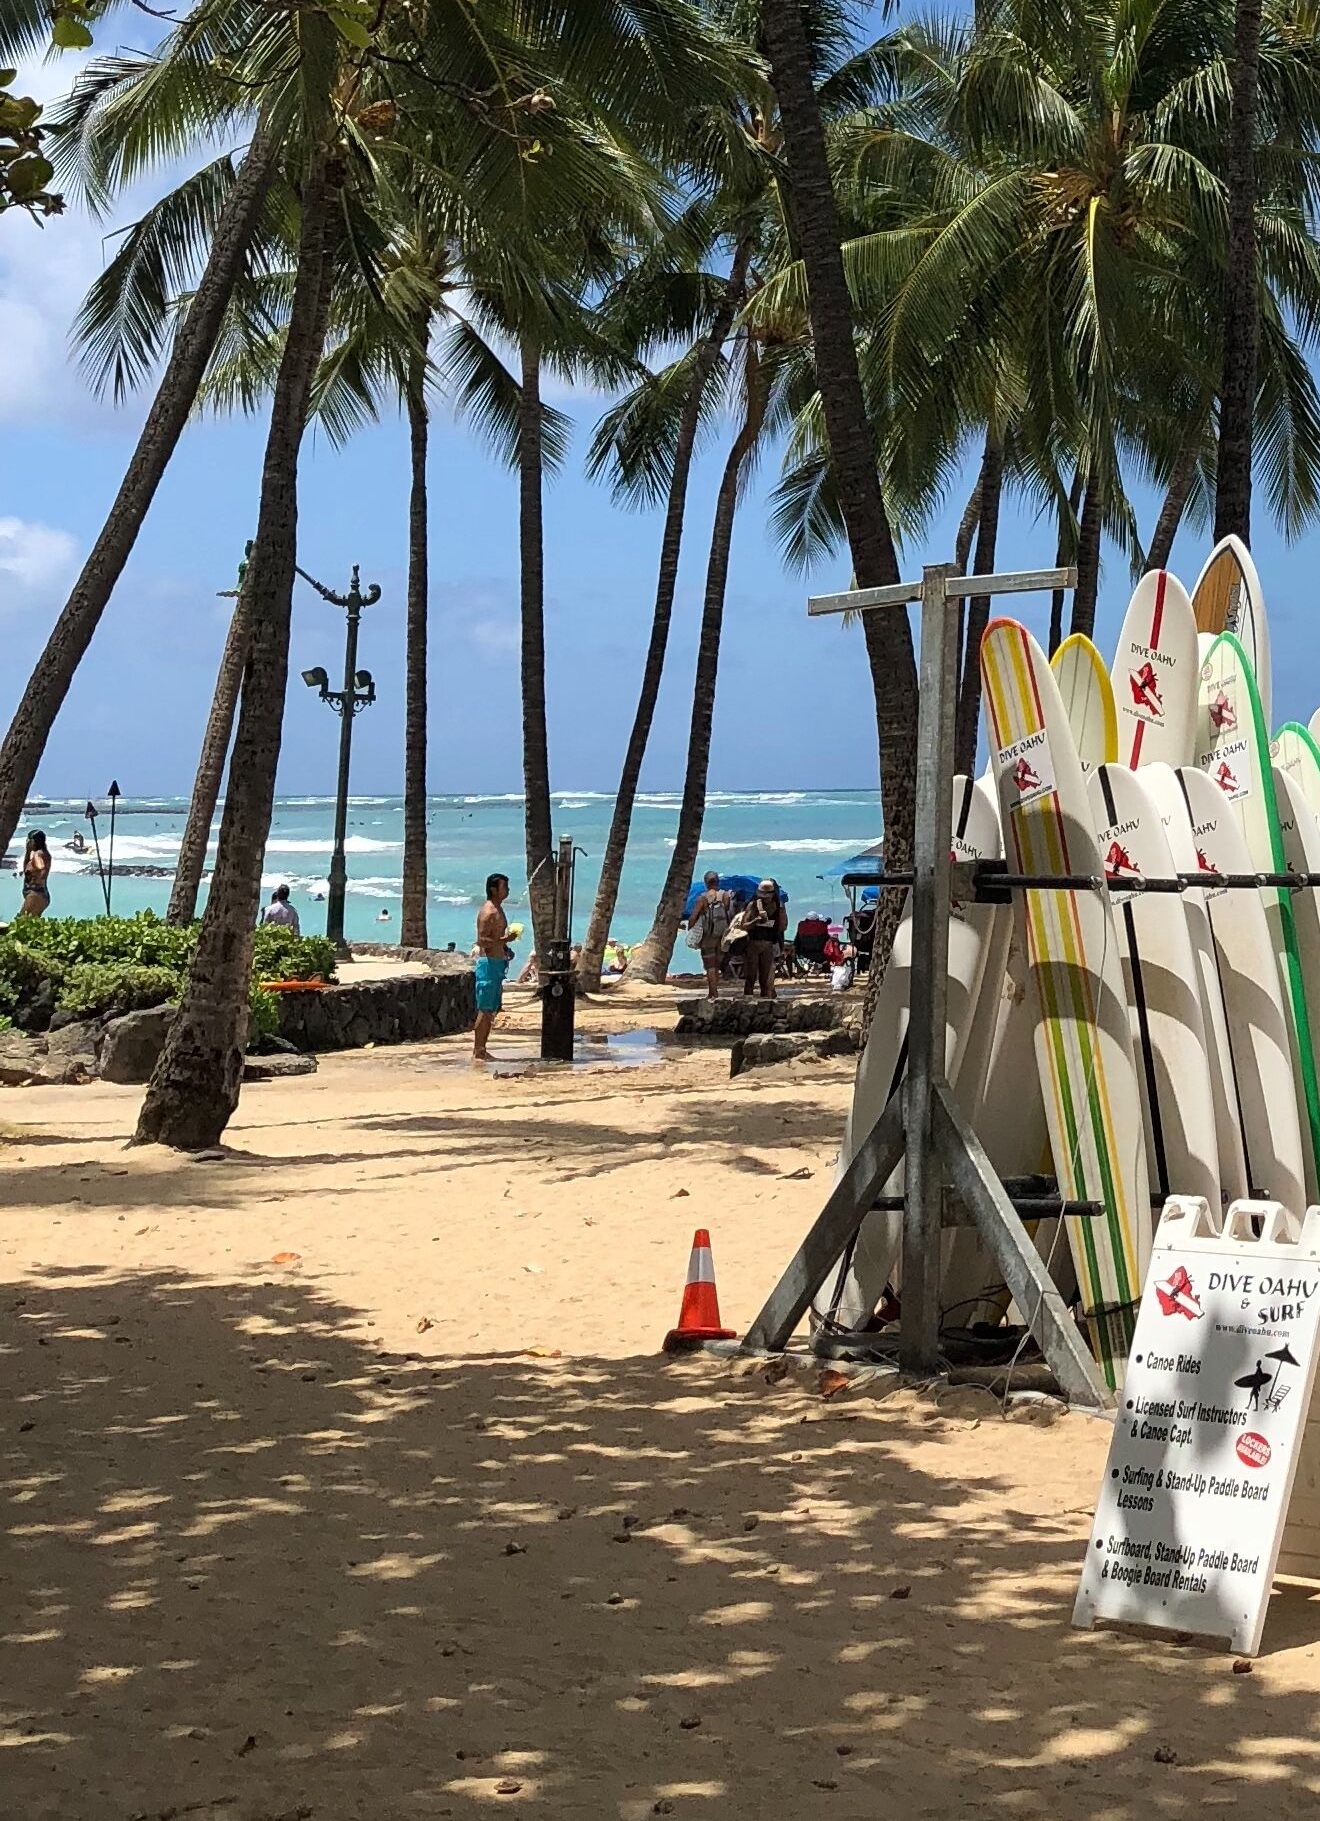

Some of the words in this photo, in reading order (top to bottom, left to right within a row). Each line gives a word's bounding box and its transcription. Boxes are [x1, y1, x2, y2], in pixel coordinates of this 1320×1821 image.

[1131, 643, 1150, 658] DIVE
[1151, 647, 1177, 667] OAHU
[999, 745, 1020, 764] DIVE
[1020, 732, 1046, 755] OAHU
[1201, 749, 1221, 766] DIVE
[1222, 740, 1248, 758] OAHU
[1096, 830, 1113, 844] IVE
[1113, 817, 1140, 838] OAHU
[1280, 820, 1295, 832] HU
[956, 838, 983, 860] OAHU
[1208, 1272, 1255, 1293] DIVE
[1258, 1277, 1319, 1298] OAHU
[1240, 1297, 1251, 1310] &
[1257, 1300, 1306, 1325] SURF
[1215, 1324, 1290, 1338] www.diveoahu.com
[1146, 1351, 1174, 1372] Canoe
[1176, 1354, 1202, 1374] Rides
[1135, 1395, 1177, 1418] Licensed
[1177, 1400, 1197, 1420] Surf
[1198, 1403, 1248, 1426] Instructors
[1130, 1419, 1139, 1438] &
[1140, 1421, 1168, 1441] Canoe
[1169, 1424, 1193, 1448] Capt.
[1122, 1464, 1155, 1491] Surfing
[1155, 1469, 1164, 1488] &
[1165, 1470, 1207, 1498] Stand-Up
[1208, 1476, 1240, 1498] Paddle
[1241, 1480, 1270, 1501] Board
[1116, 1488, 1154, 1512] Lessons
[1106, 1535, 1152, 1560] Surfboard,
[1154, 1541, 1196, 1570] Stand-Up
[1197, 1548, 1230, 1572] Paddle
[1230, 1552, 1260, 1574] Board
[1101, 1559, 1110, 1579] &
[1111, 1561, 1143, 1587] Boogie
[1143, 1566, 1173, 1588] Board
[1172, 1570, 1208, 1593] Rentals
